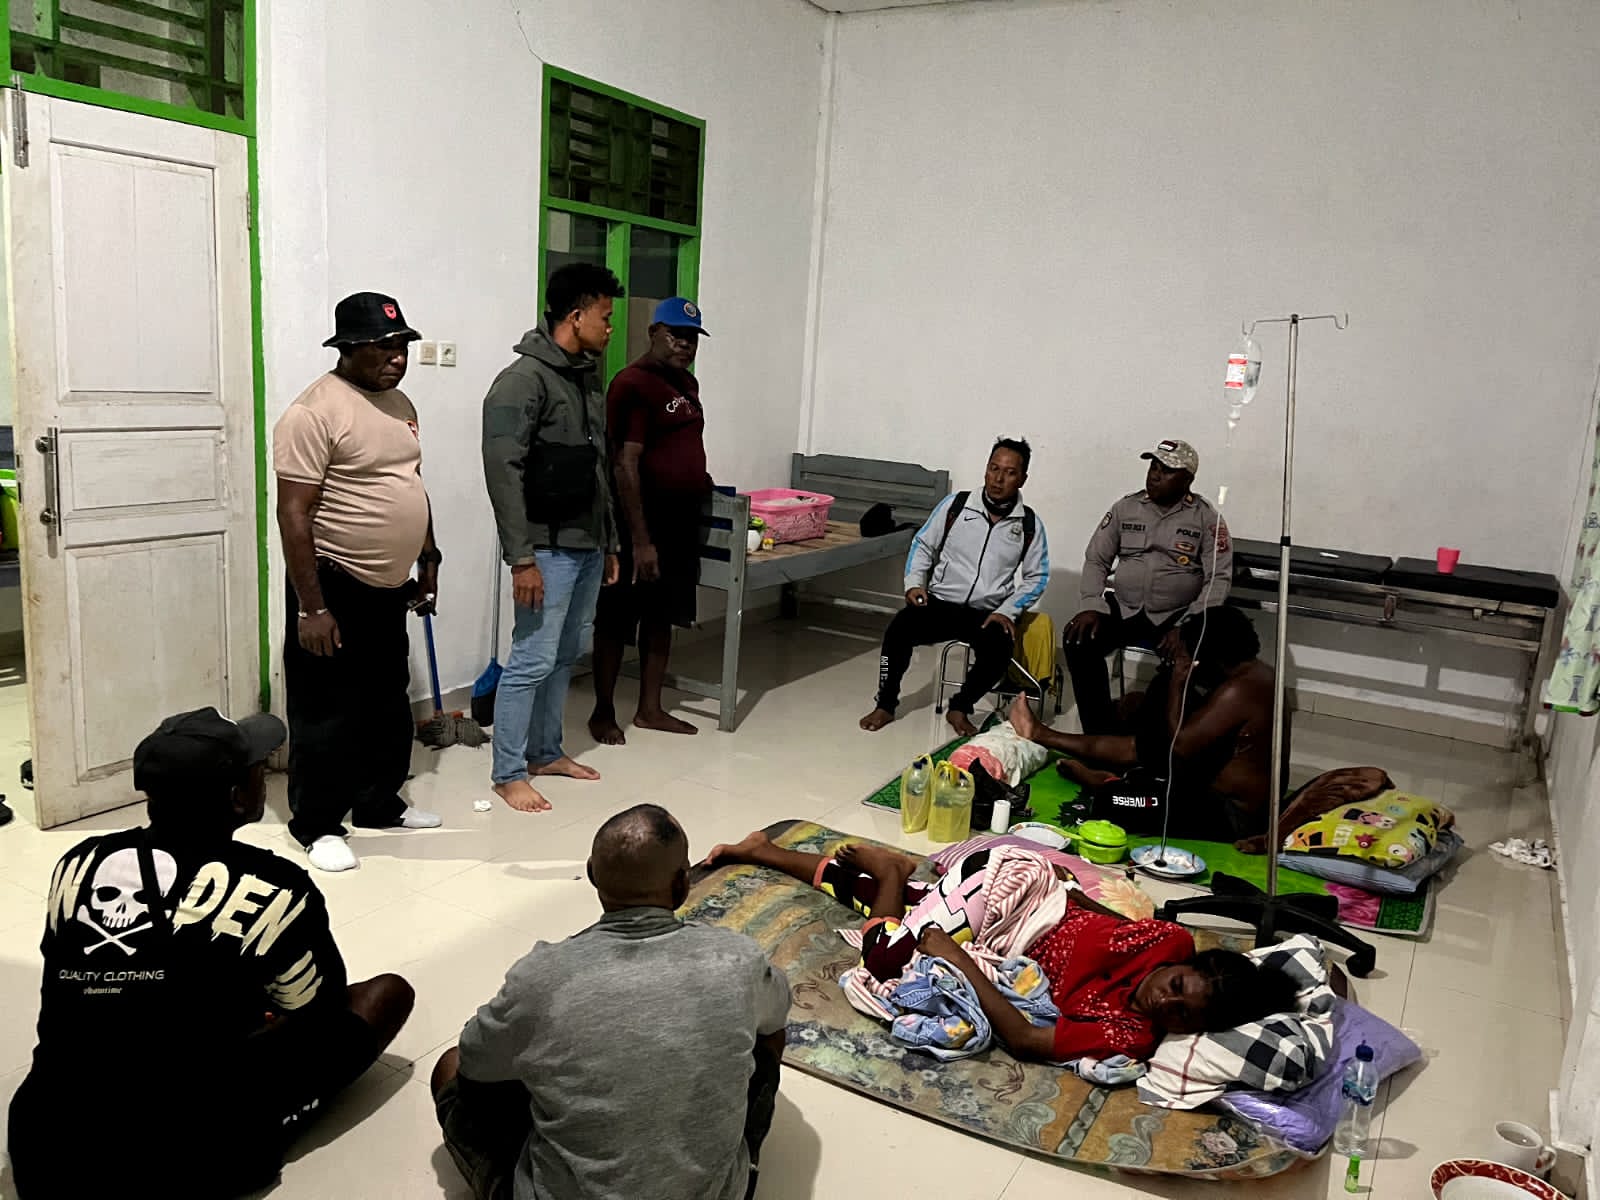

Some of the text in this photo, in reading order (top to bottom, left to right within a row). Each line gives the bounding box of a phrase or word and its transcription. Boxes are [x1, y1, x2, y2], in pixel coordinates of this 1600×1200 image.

[172, 861, 310, 957] DEN
[59, 969, 165, 982] QUALITY CLOTHING
